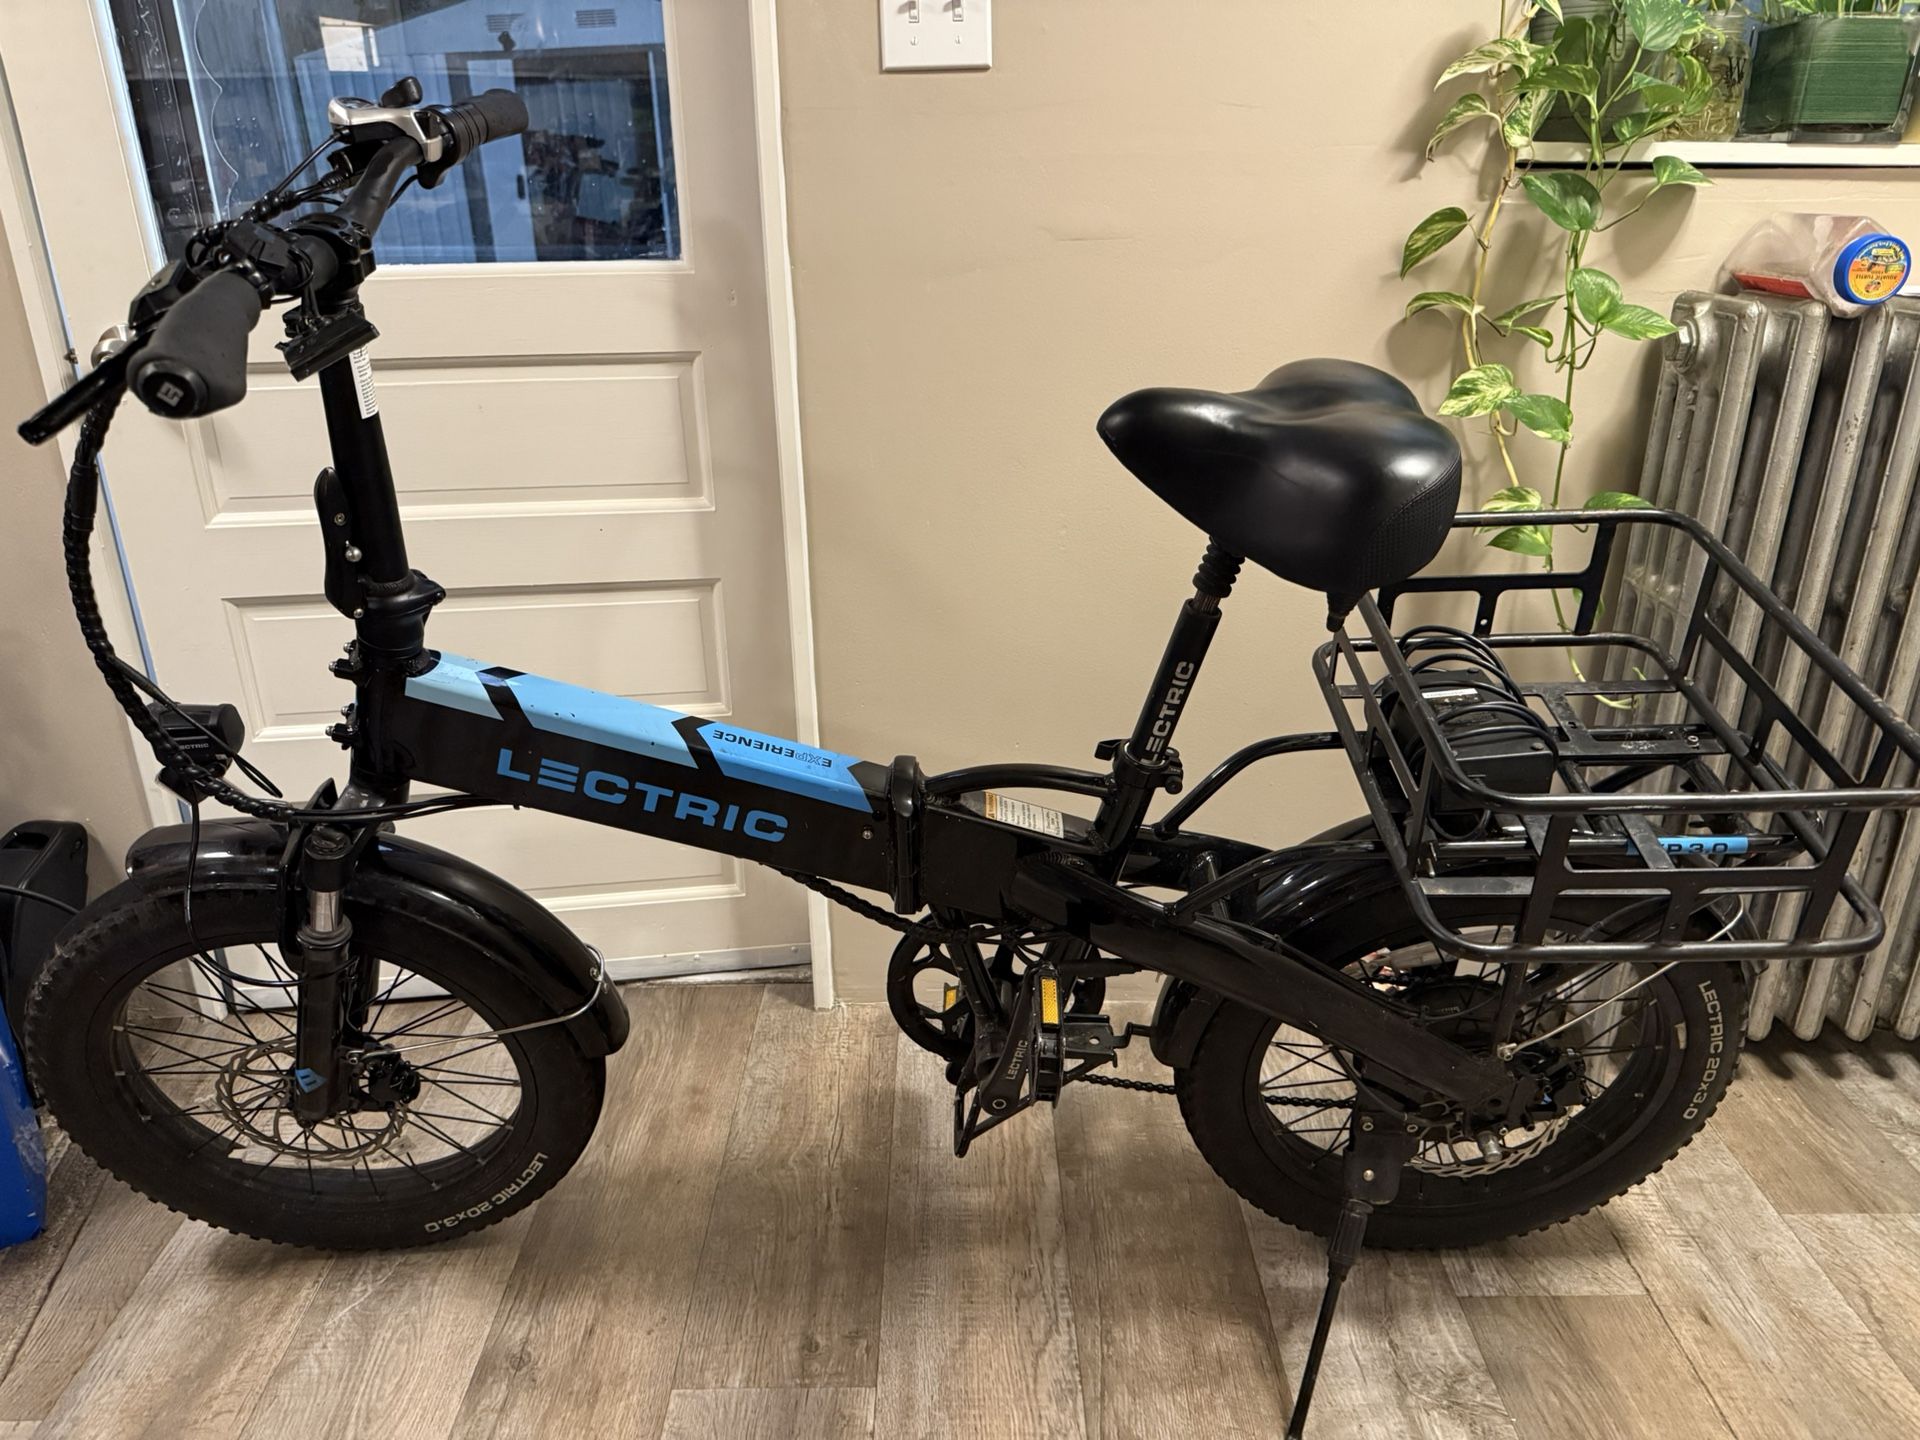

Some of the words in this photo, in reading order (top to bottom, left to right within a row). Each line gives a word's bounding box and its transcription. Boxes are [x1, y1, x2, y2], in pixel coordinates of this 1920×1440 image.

[712, 729, 832, 768] EXPERIENCE
[497, 748, 789, 844] LECTRIC
[1698, 980, 1724, 1054] LECTRIC
[1005, 1040, 1028, 1080] LECTRIC
[1682, 1057, 1721, 1120] 20x3.0
[491, 1151, 549, 1205] LECTRIC
[424, 1201, 493, 1233] 20x3.0
